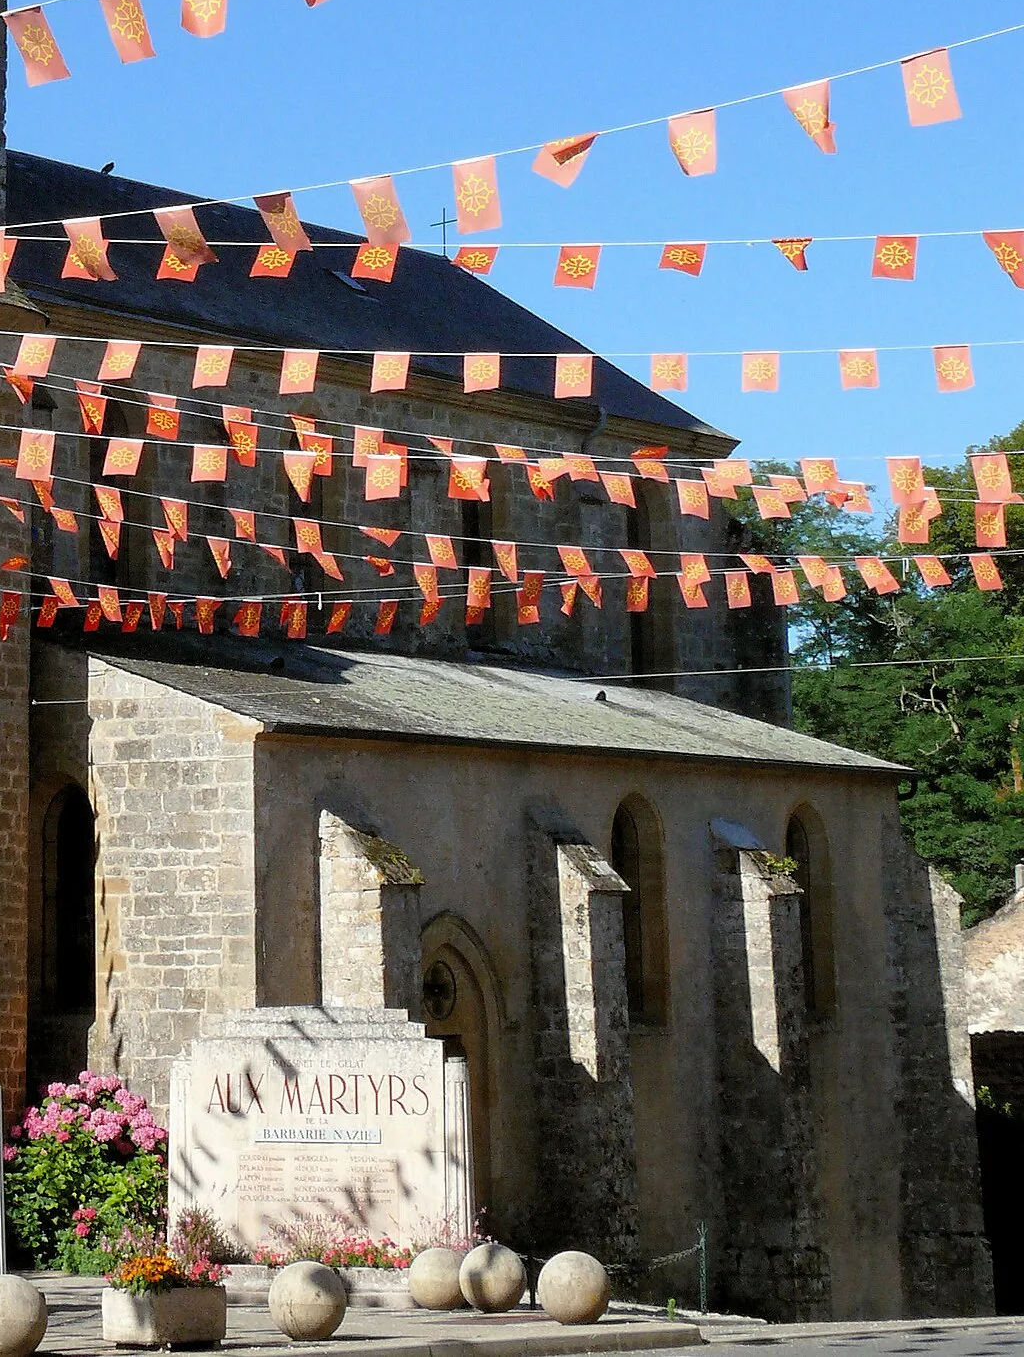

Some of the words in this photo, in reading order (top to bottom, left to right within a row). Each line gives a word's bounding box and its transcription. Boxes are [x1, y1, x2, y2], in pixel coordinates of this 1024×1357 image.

[207, 1073, 265, 1114] AUX
[280, 1073, 430, 1116] MARTYRS
[263, 1128, 327, 1139] BARBARIE
